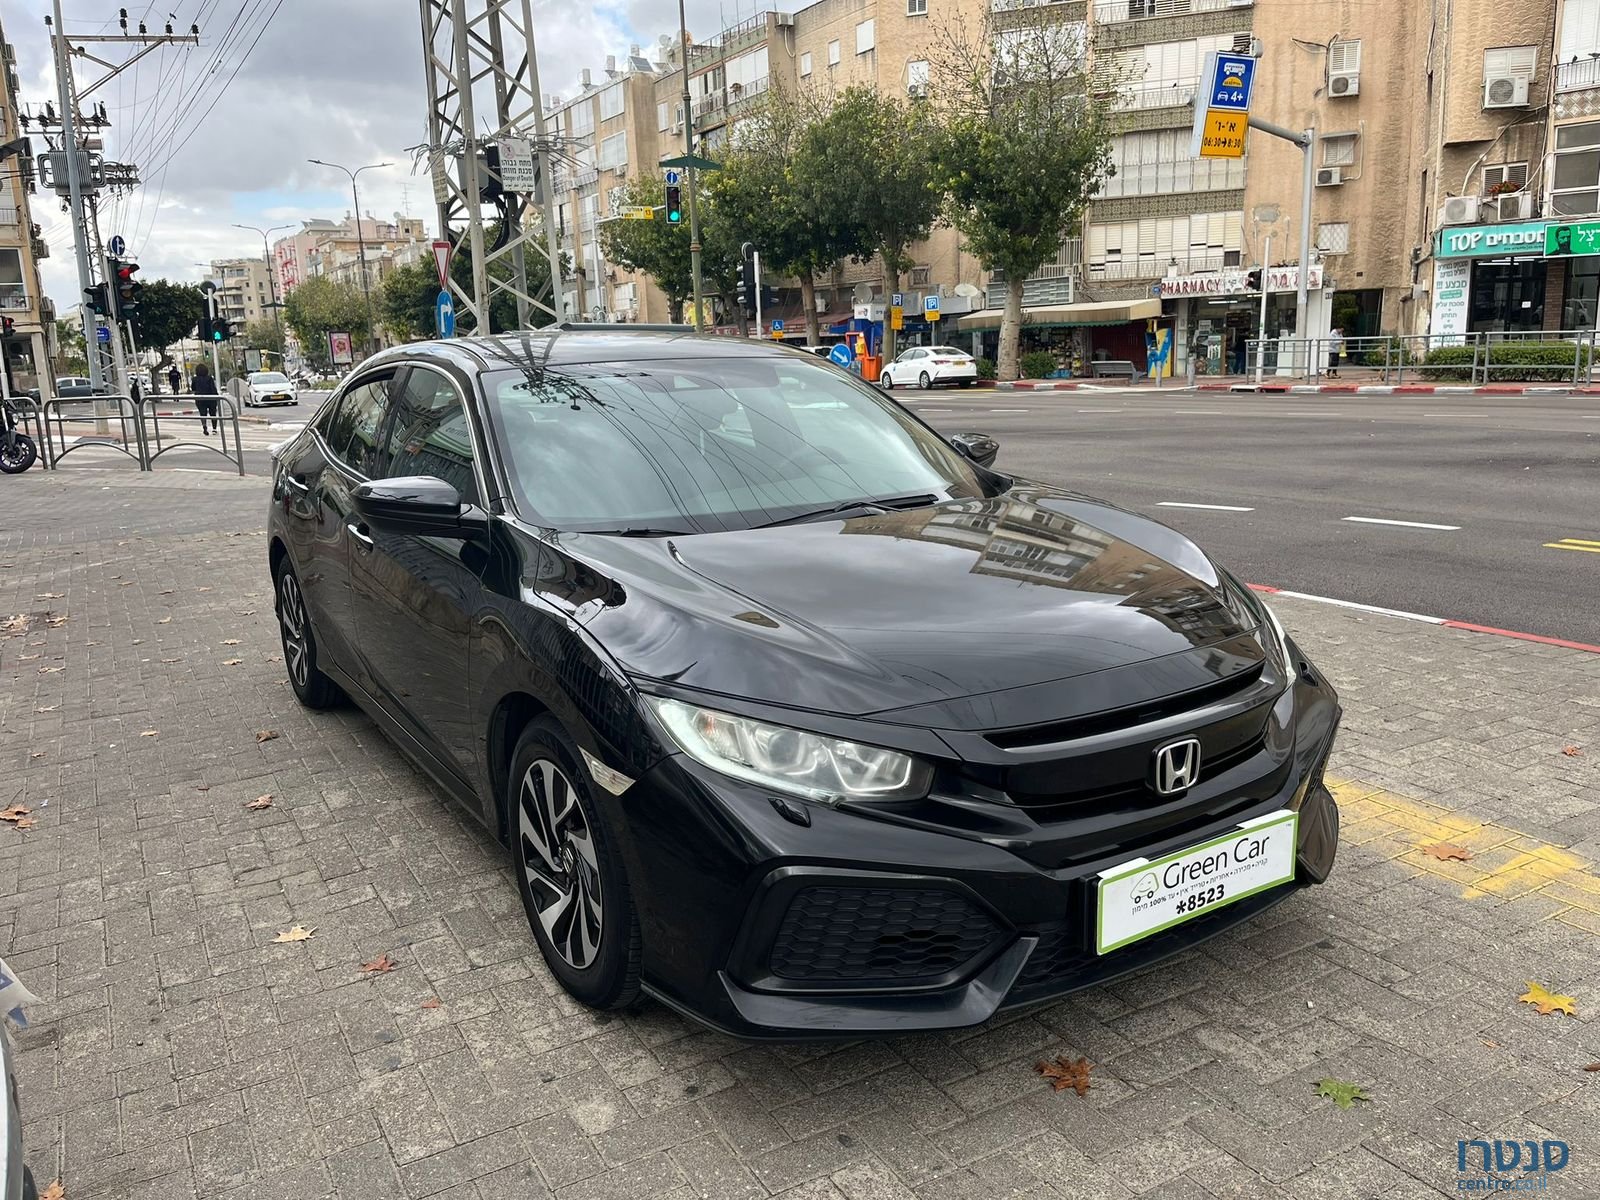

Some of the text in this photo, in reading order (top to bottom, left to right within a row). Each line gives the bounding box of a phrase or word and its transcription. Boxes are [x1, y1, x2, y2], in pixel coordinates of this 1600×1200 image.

[1230, 90, 1244, 102] 4+
[1448, 232, 1482, 251] TOP
[1161, 278, 1221, 295] PHARMACY
[1445, 280, 1468, 289] מבצע
[1163, 836, 1270, 889] Green Car
[1254, 857, 1268, 868] קניה
[1233, 863, 1251, 876] מכירה
[1209, 871, 1230, 885] אחריות
[1190, 879, 1206, 891] טרייד
[1149, 895, 1167, 908] 100%
[1168, 892, 1176, 900] עד
[1131, 902, 1148, 916] מימון
